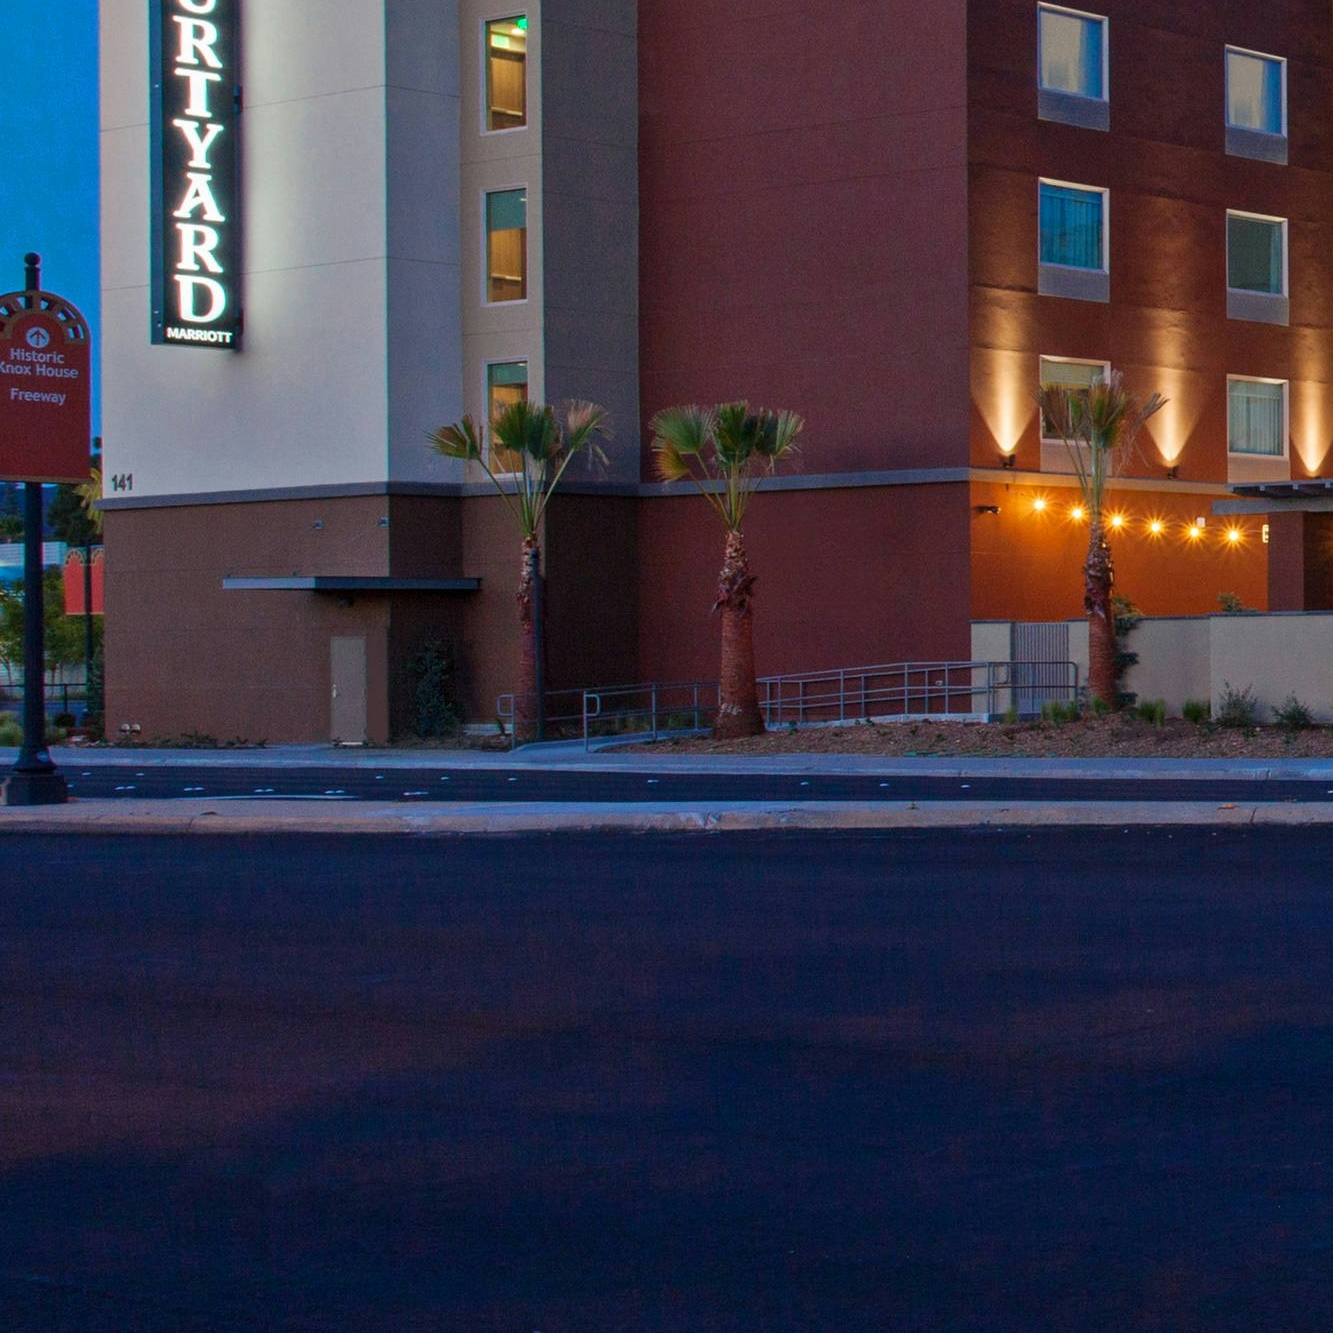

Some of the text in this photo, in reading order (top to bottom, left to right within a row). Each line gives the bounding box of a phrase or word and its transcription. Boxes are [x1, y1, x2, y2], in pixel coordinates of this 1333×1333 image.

[166, 327, 233, 343] MARRIOTT
[10, 348, 65, 364] Historic
[36, 363, 79, 379] House
[10, 387, 67, 406] Freeway
[111, 474, 134, 492] 141
